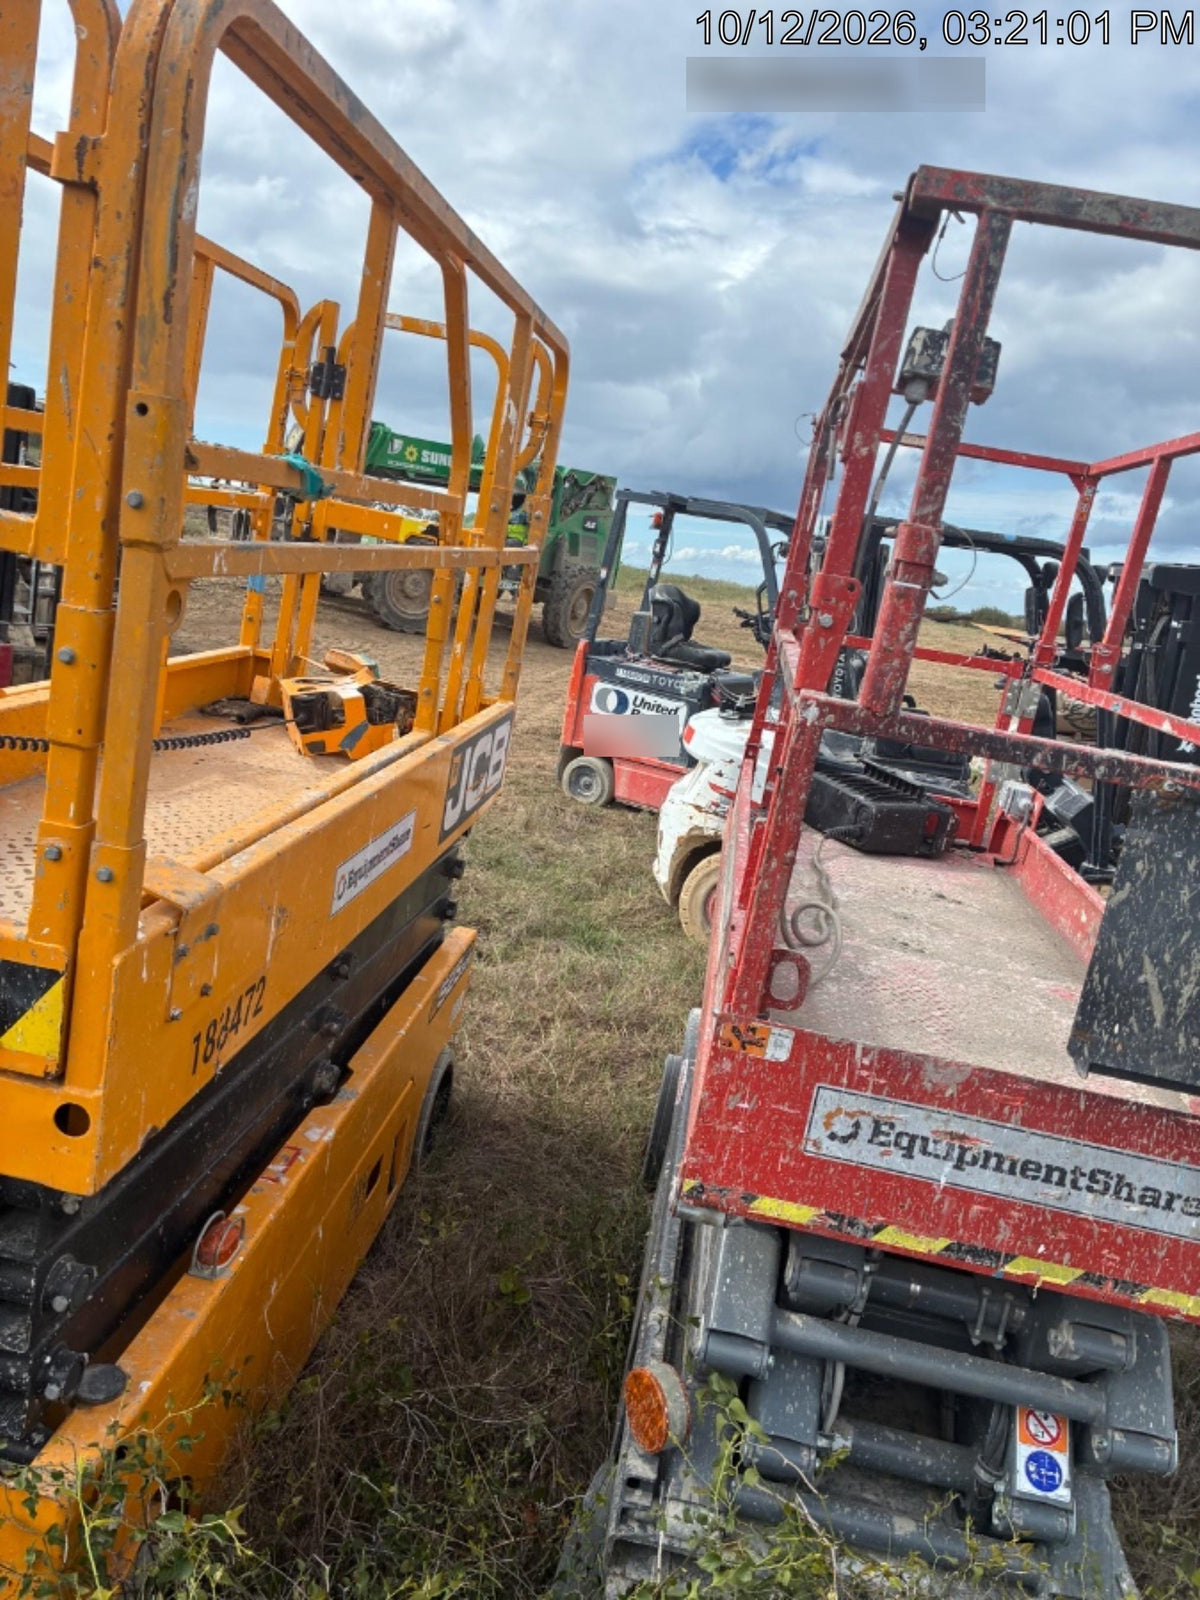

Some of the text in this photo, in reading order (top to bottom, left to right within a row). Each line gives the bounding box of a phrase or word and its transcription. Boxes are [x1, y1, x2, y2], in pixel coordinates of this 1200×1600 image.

[650, 674, 690, 690] TOYO
[632, 695, 680, 716] United
[444, 721, 511, 831] JCB
